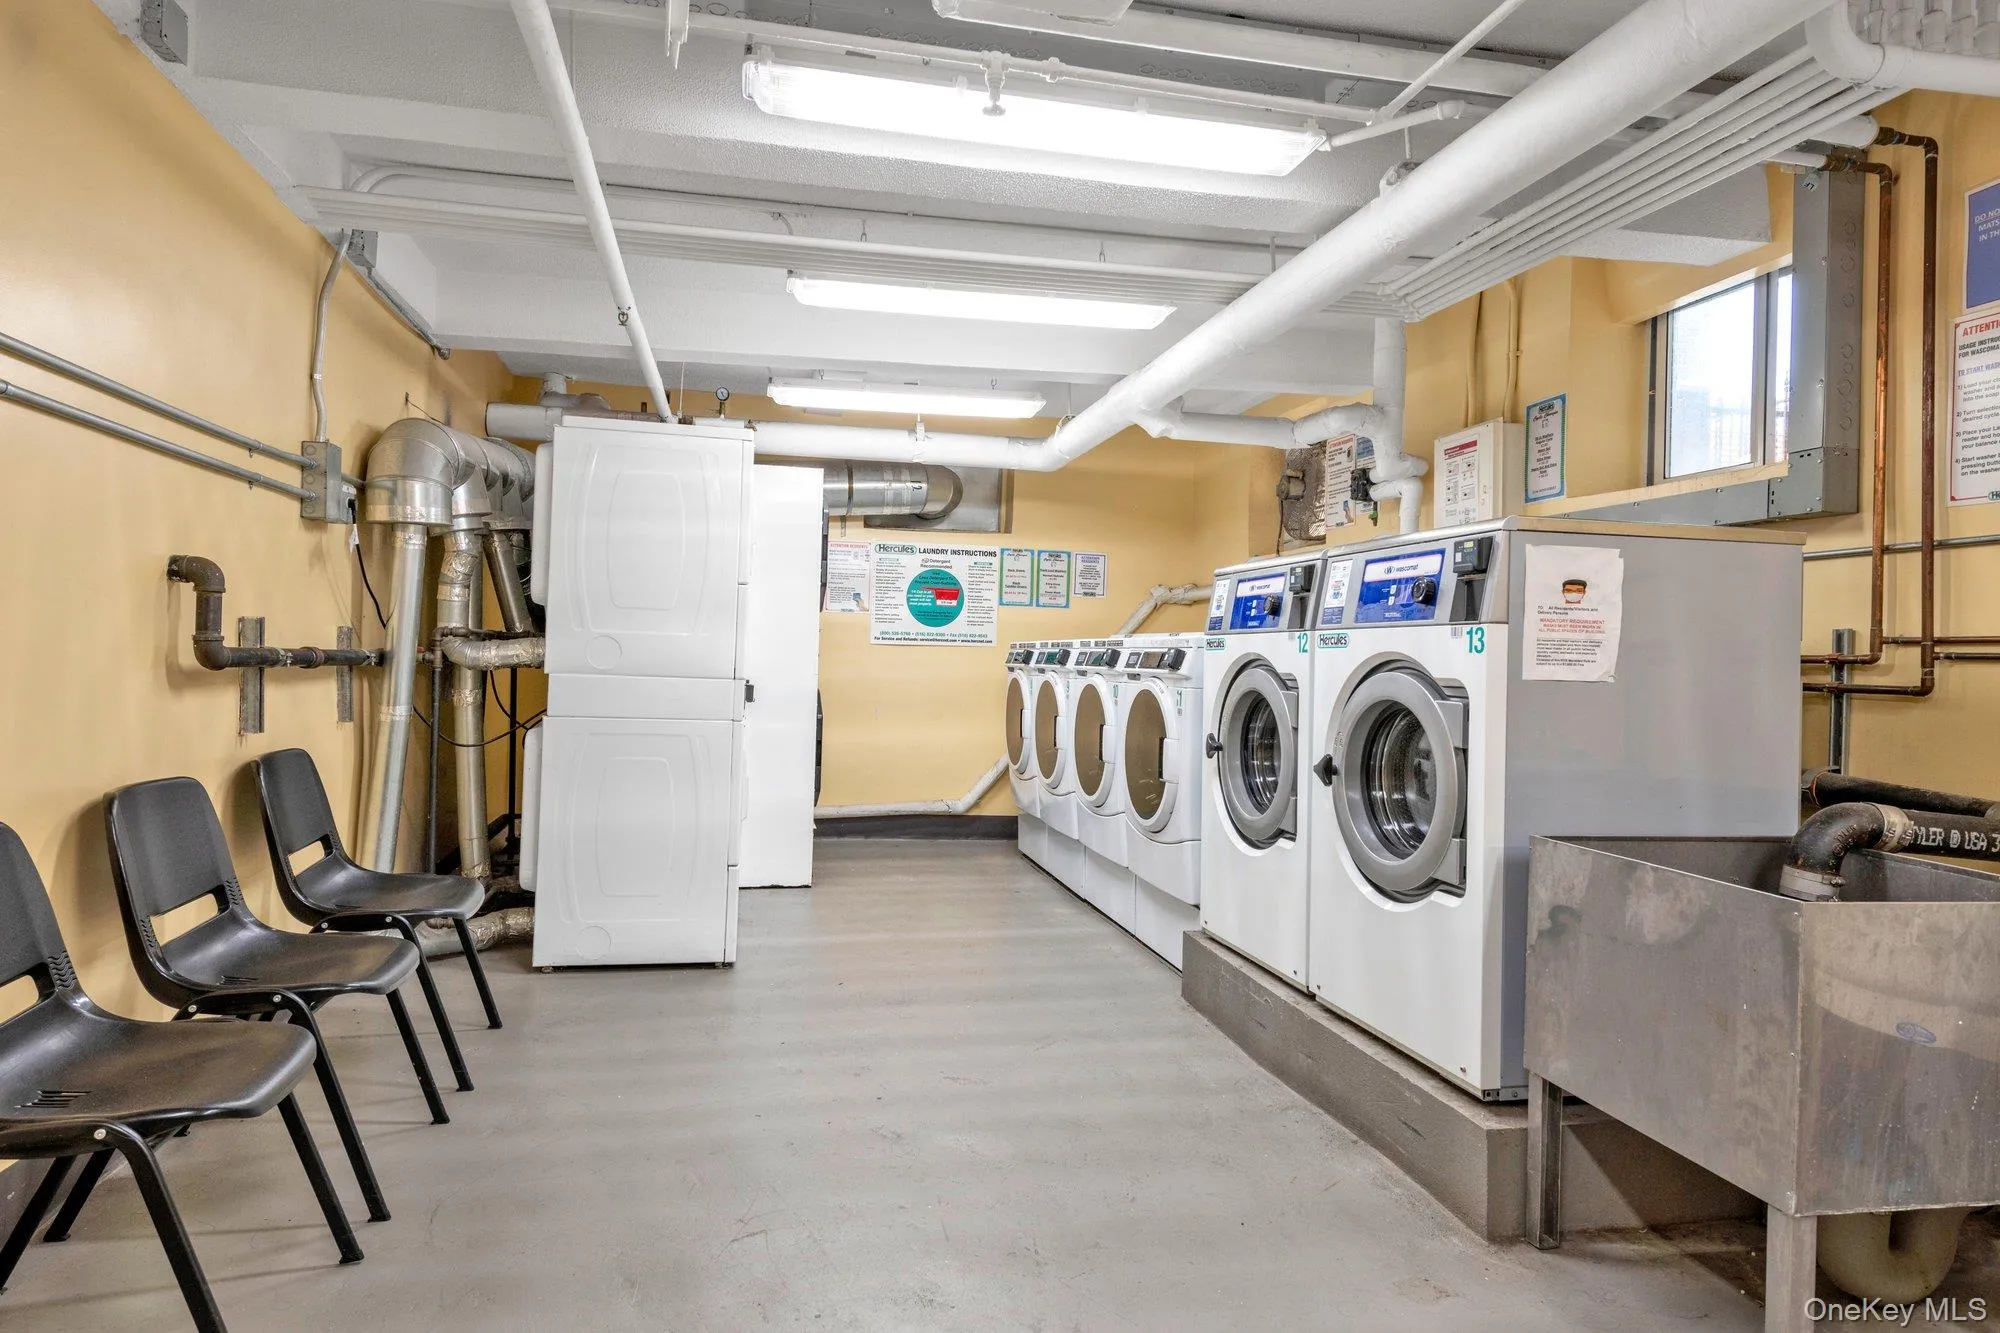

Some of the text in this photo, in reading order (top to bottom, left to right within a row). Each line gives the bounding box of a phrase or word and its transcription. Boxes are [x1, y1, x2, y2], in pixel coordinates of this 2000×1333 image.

[877, 543, 997, 558] Hercules LAUNDRY INSTRUCTIONS
[1297, 632, 1309, 653] 12
[1319, 634, 1349, 646] Hercules
[1466, 627, 1485, 654] 13
